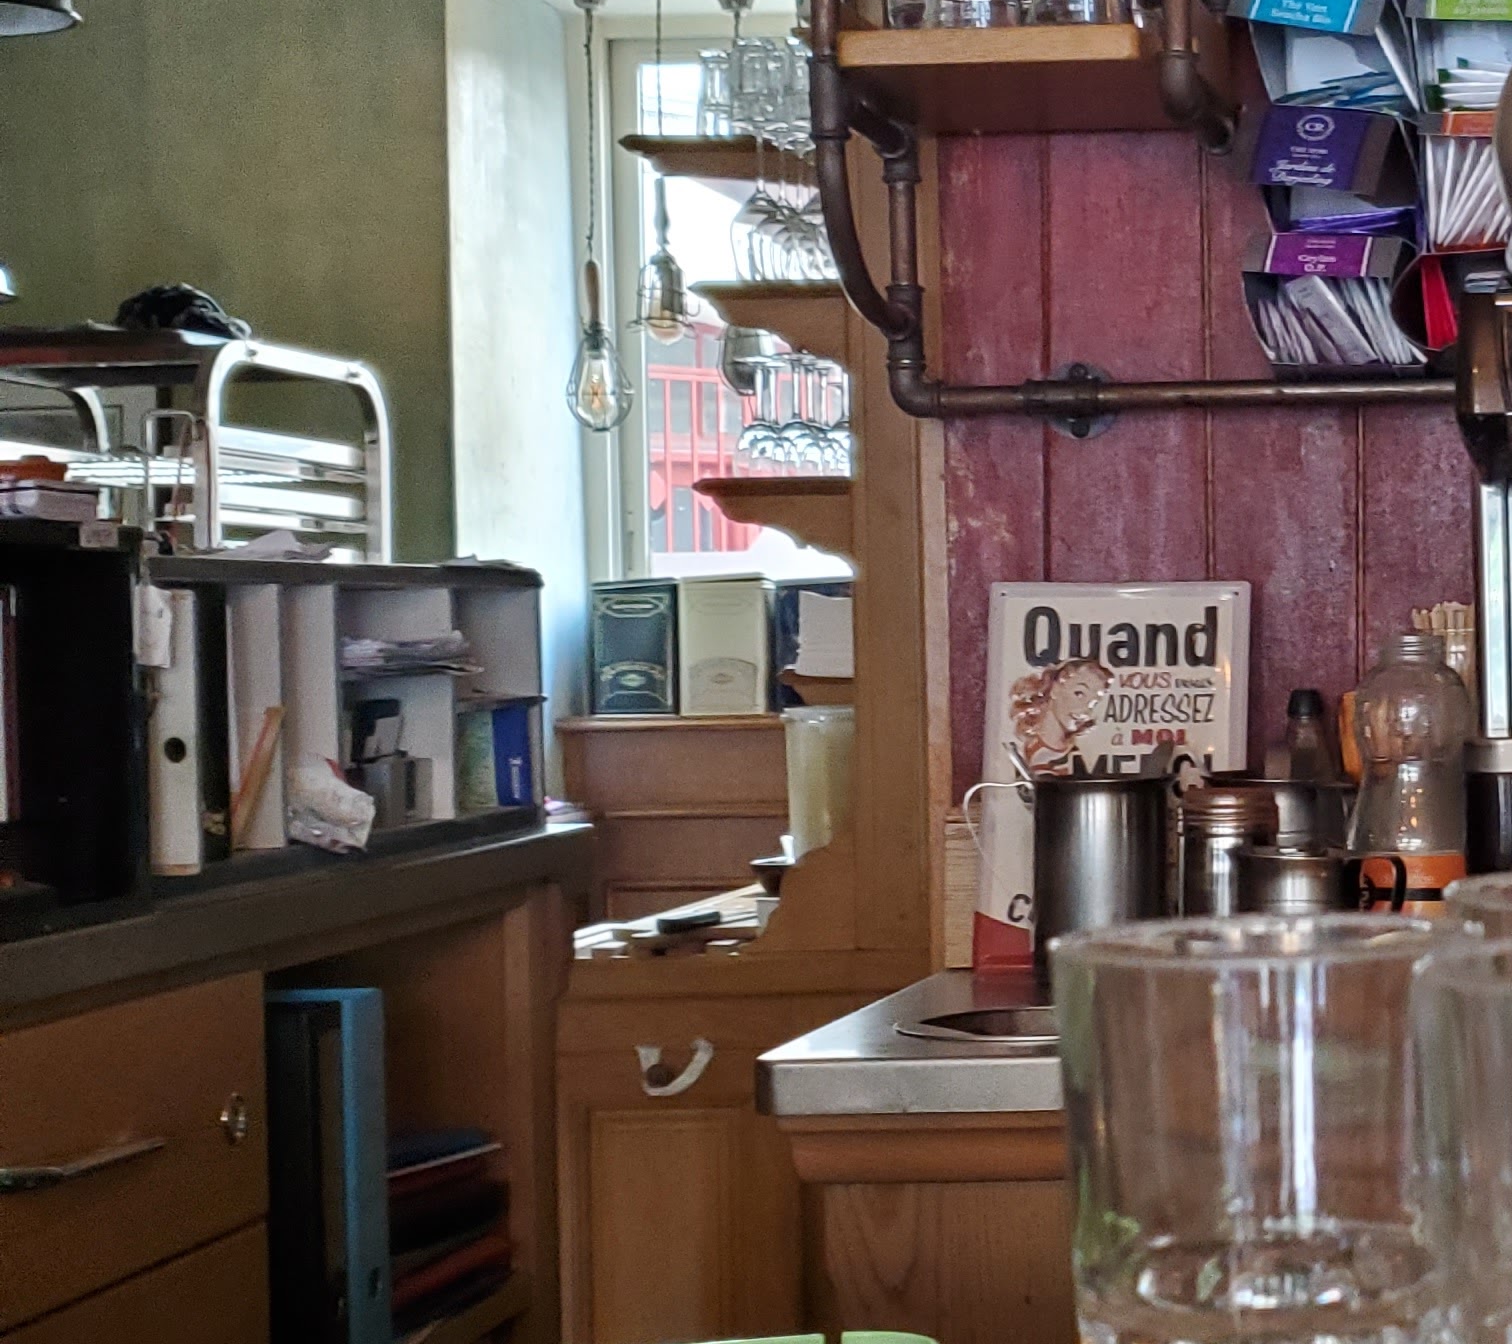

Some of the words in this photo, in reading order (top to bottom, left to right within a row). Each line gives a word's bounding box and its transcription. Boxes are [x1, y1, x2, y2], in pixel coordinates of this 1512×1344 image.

[1023, 605, 1219, 668] Quand
[1118, 671, 1172, 690] VOUS
[1103, 693, 1216, 725] ADRESSEZ
[1131, 728, 1187, 746] MOI
